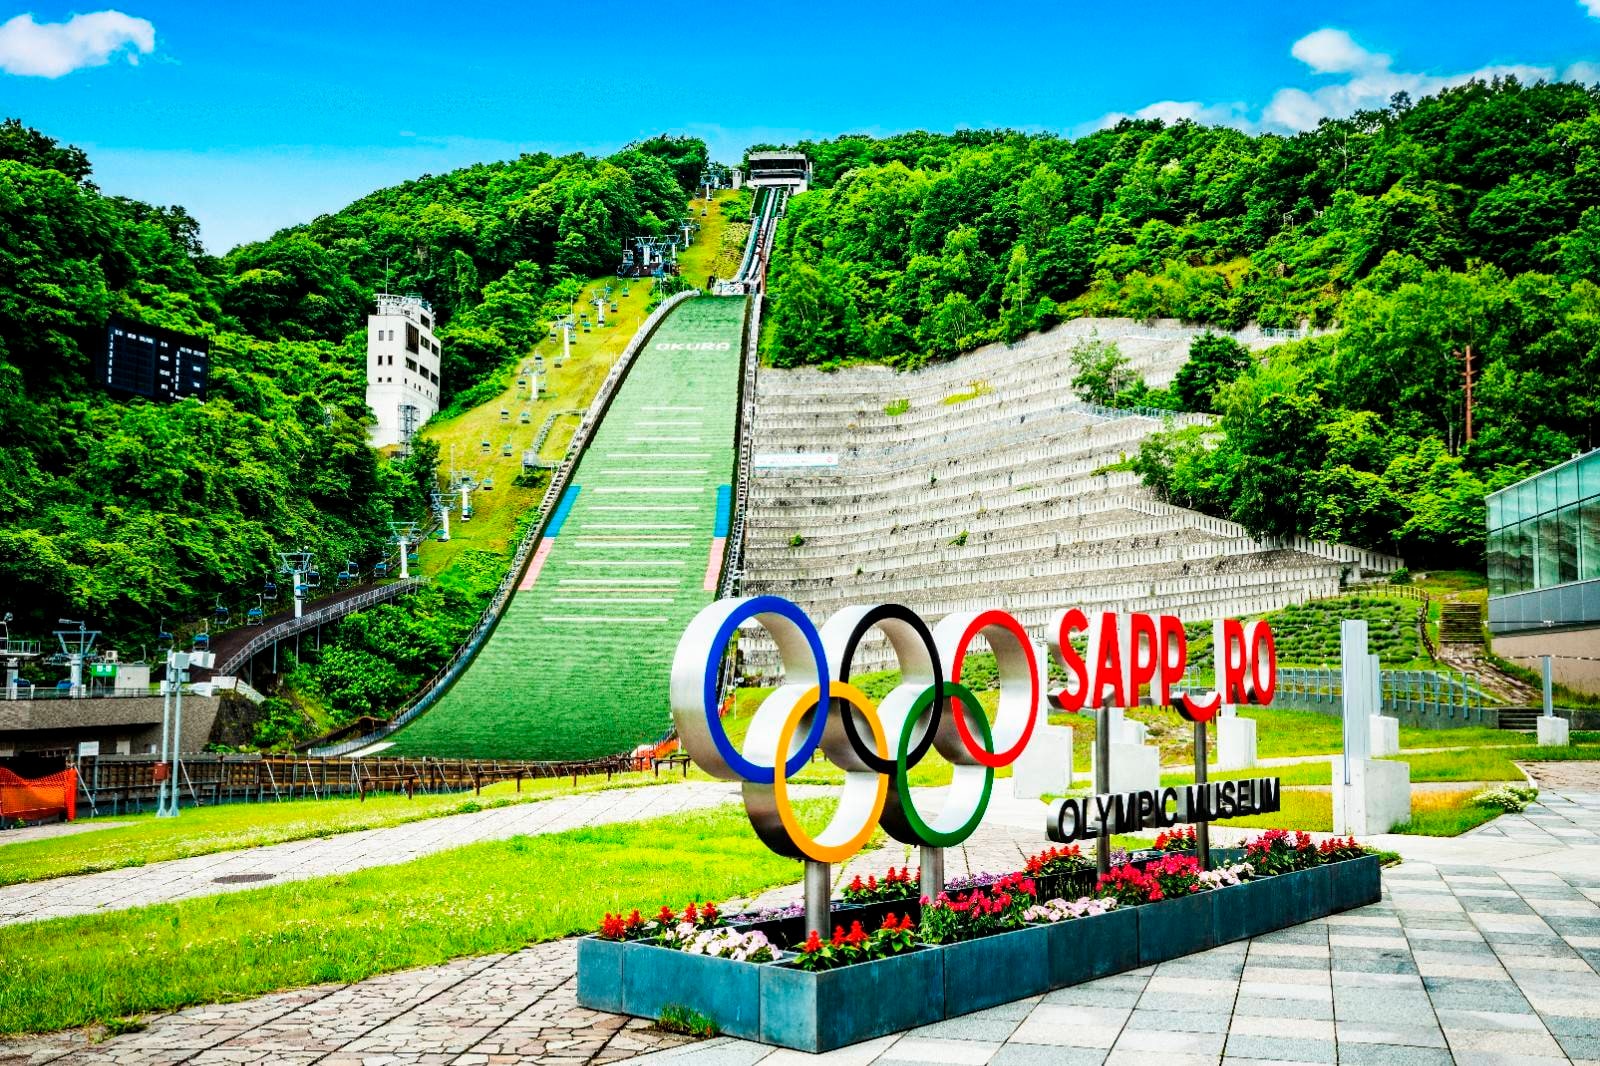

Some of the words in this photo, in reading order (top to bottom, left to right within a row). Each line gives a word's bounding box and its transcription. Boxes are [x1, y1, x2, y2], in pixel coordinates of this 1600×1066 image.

[656, 342, 731, 351] OKURA
[1057, 787, 1178, 844] OLYMPIC
[1187, 777, 1281, 824] MUSEUM
